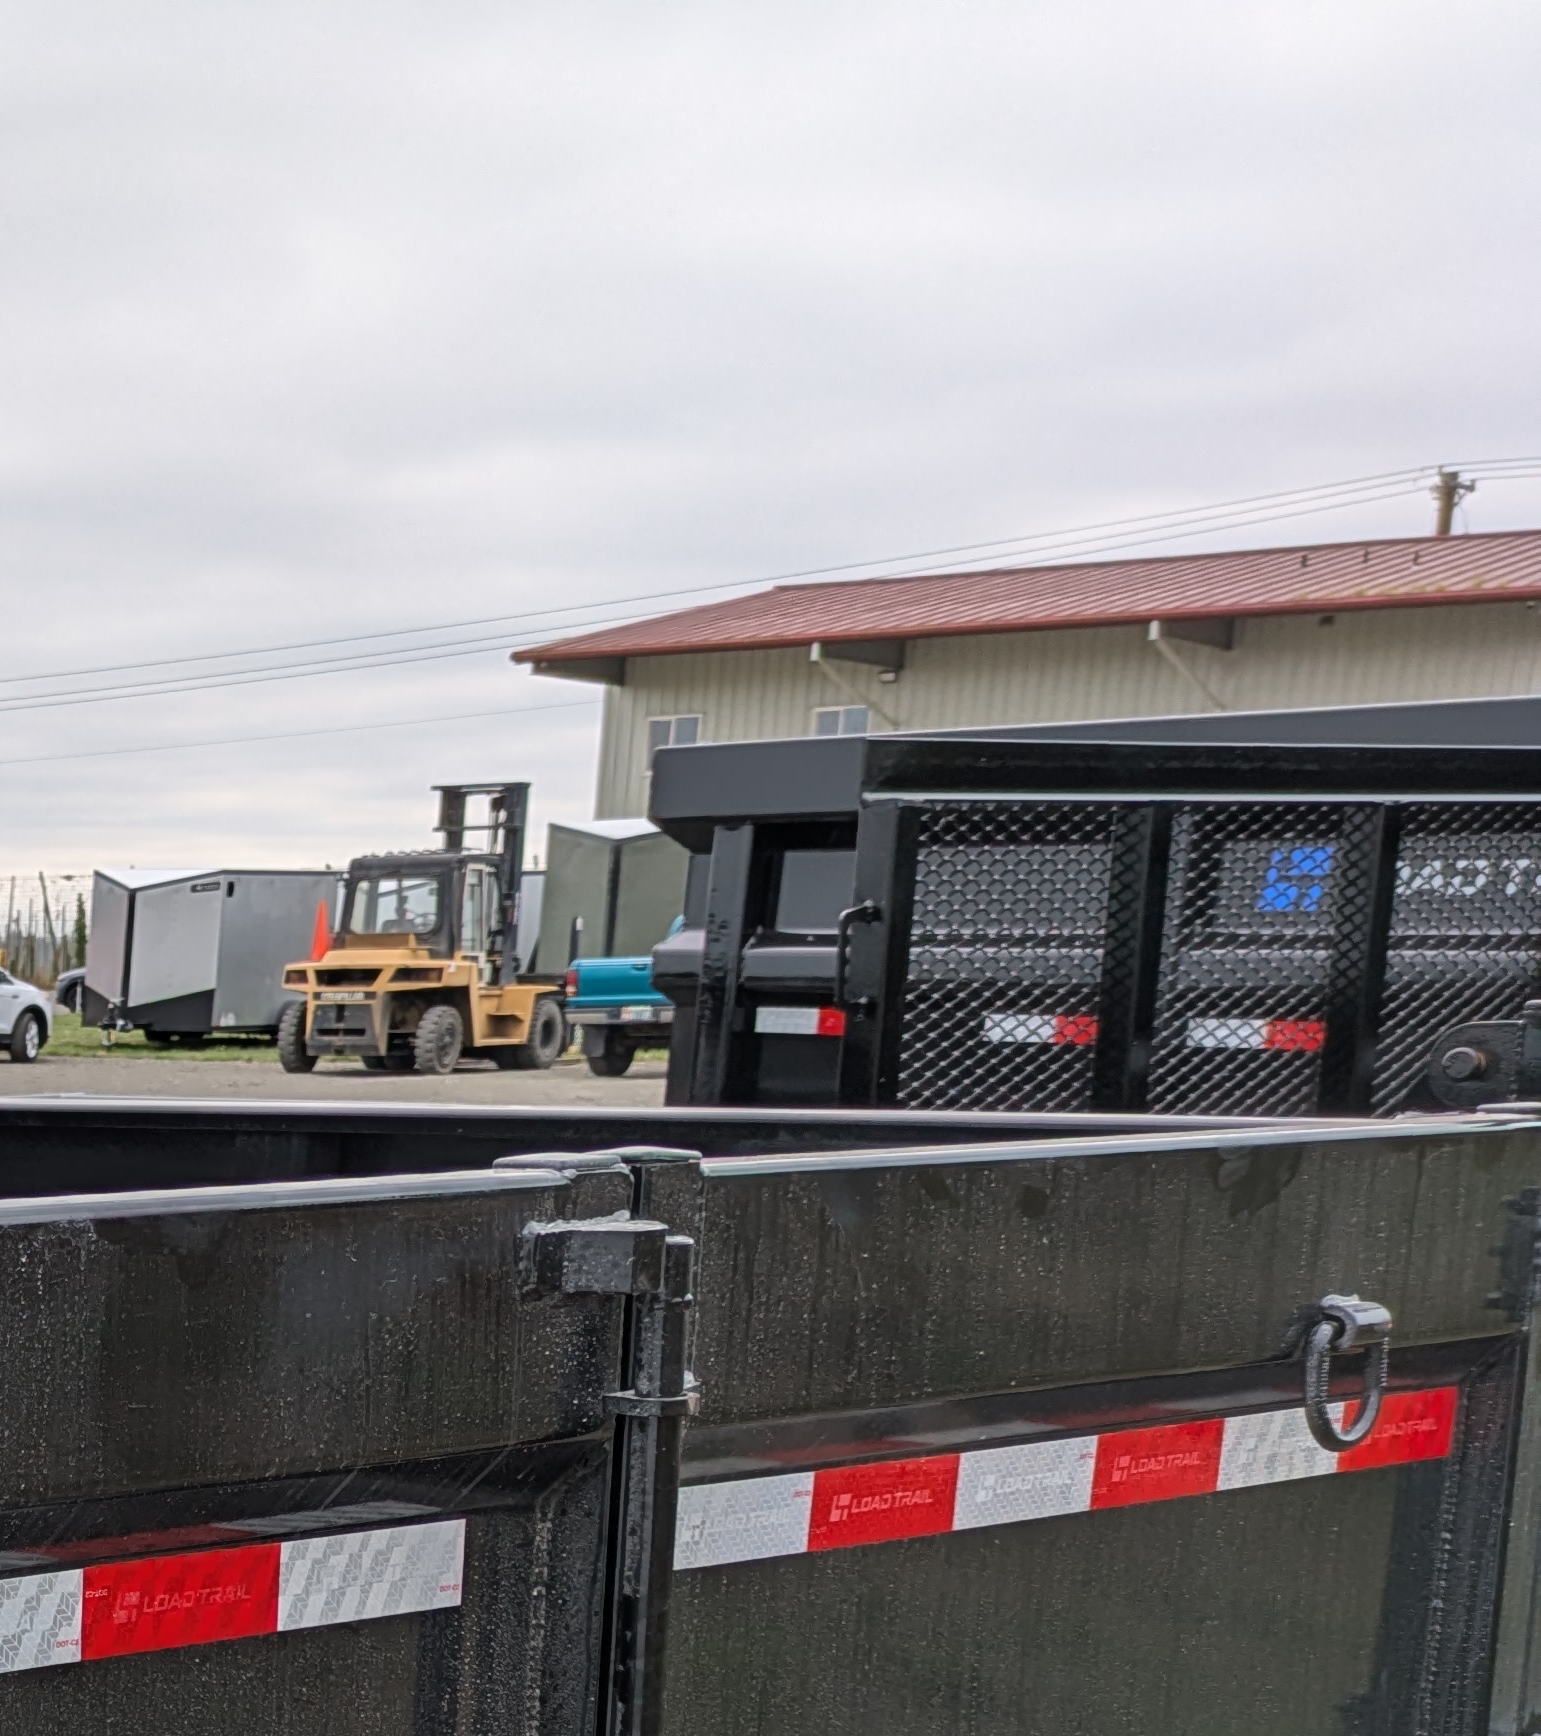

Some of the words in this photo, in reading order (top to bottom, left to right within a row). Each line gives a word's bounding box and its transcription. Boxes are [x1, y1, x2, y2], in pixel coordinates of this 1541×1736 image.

[1130, 1456, 1166, 1474] LOAD
[1167, 1451, 1201, 1467] TRAIL
[851, 1493, 891, 1513] LOAD
[893, 1489, 933, 1507] TRAIL
[143, 1590, 195, 1613] LOAD
[197, 1583, 252, 1605] TRAIL
